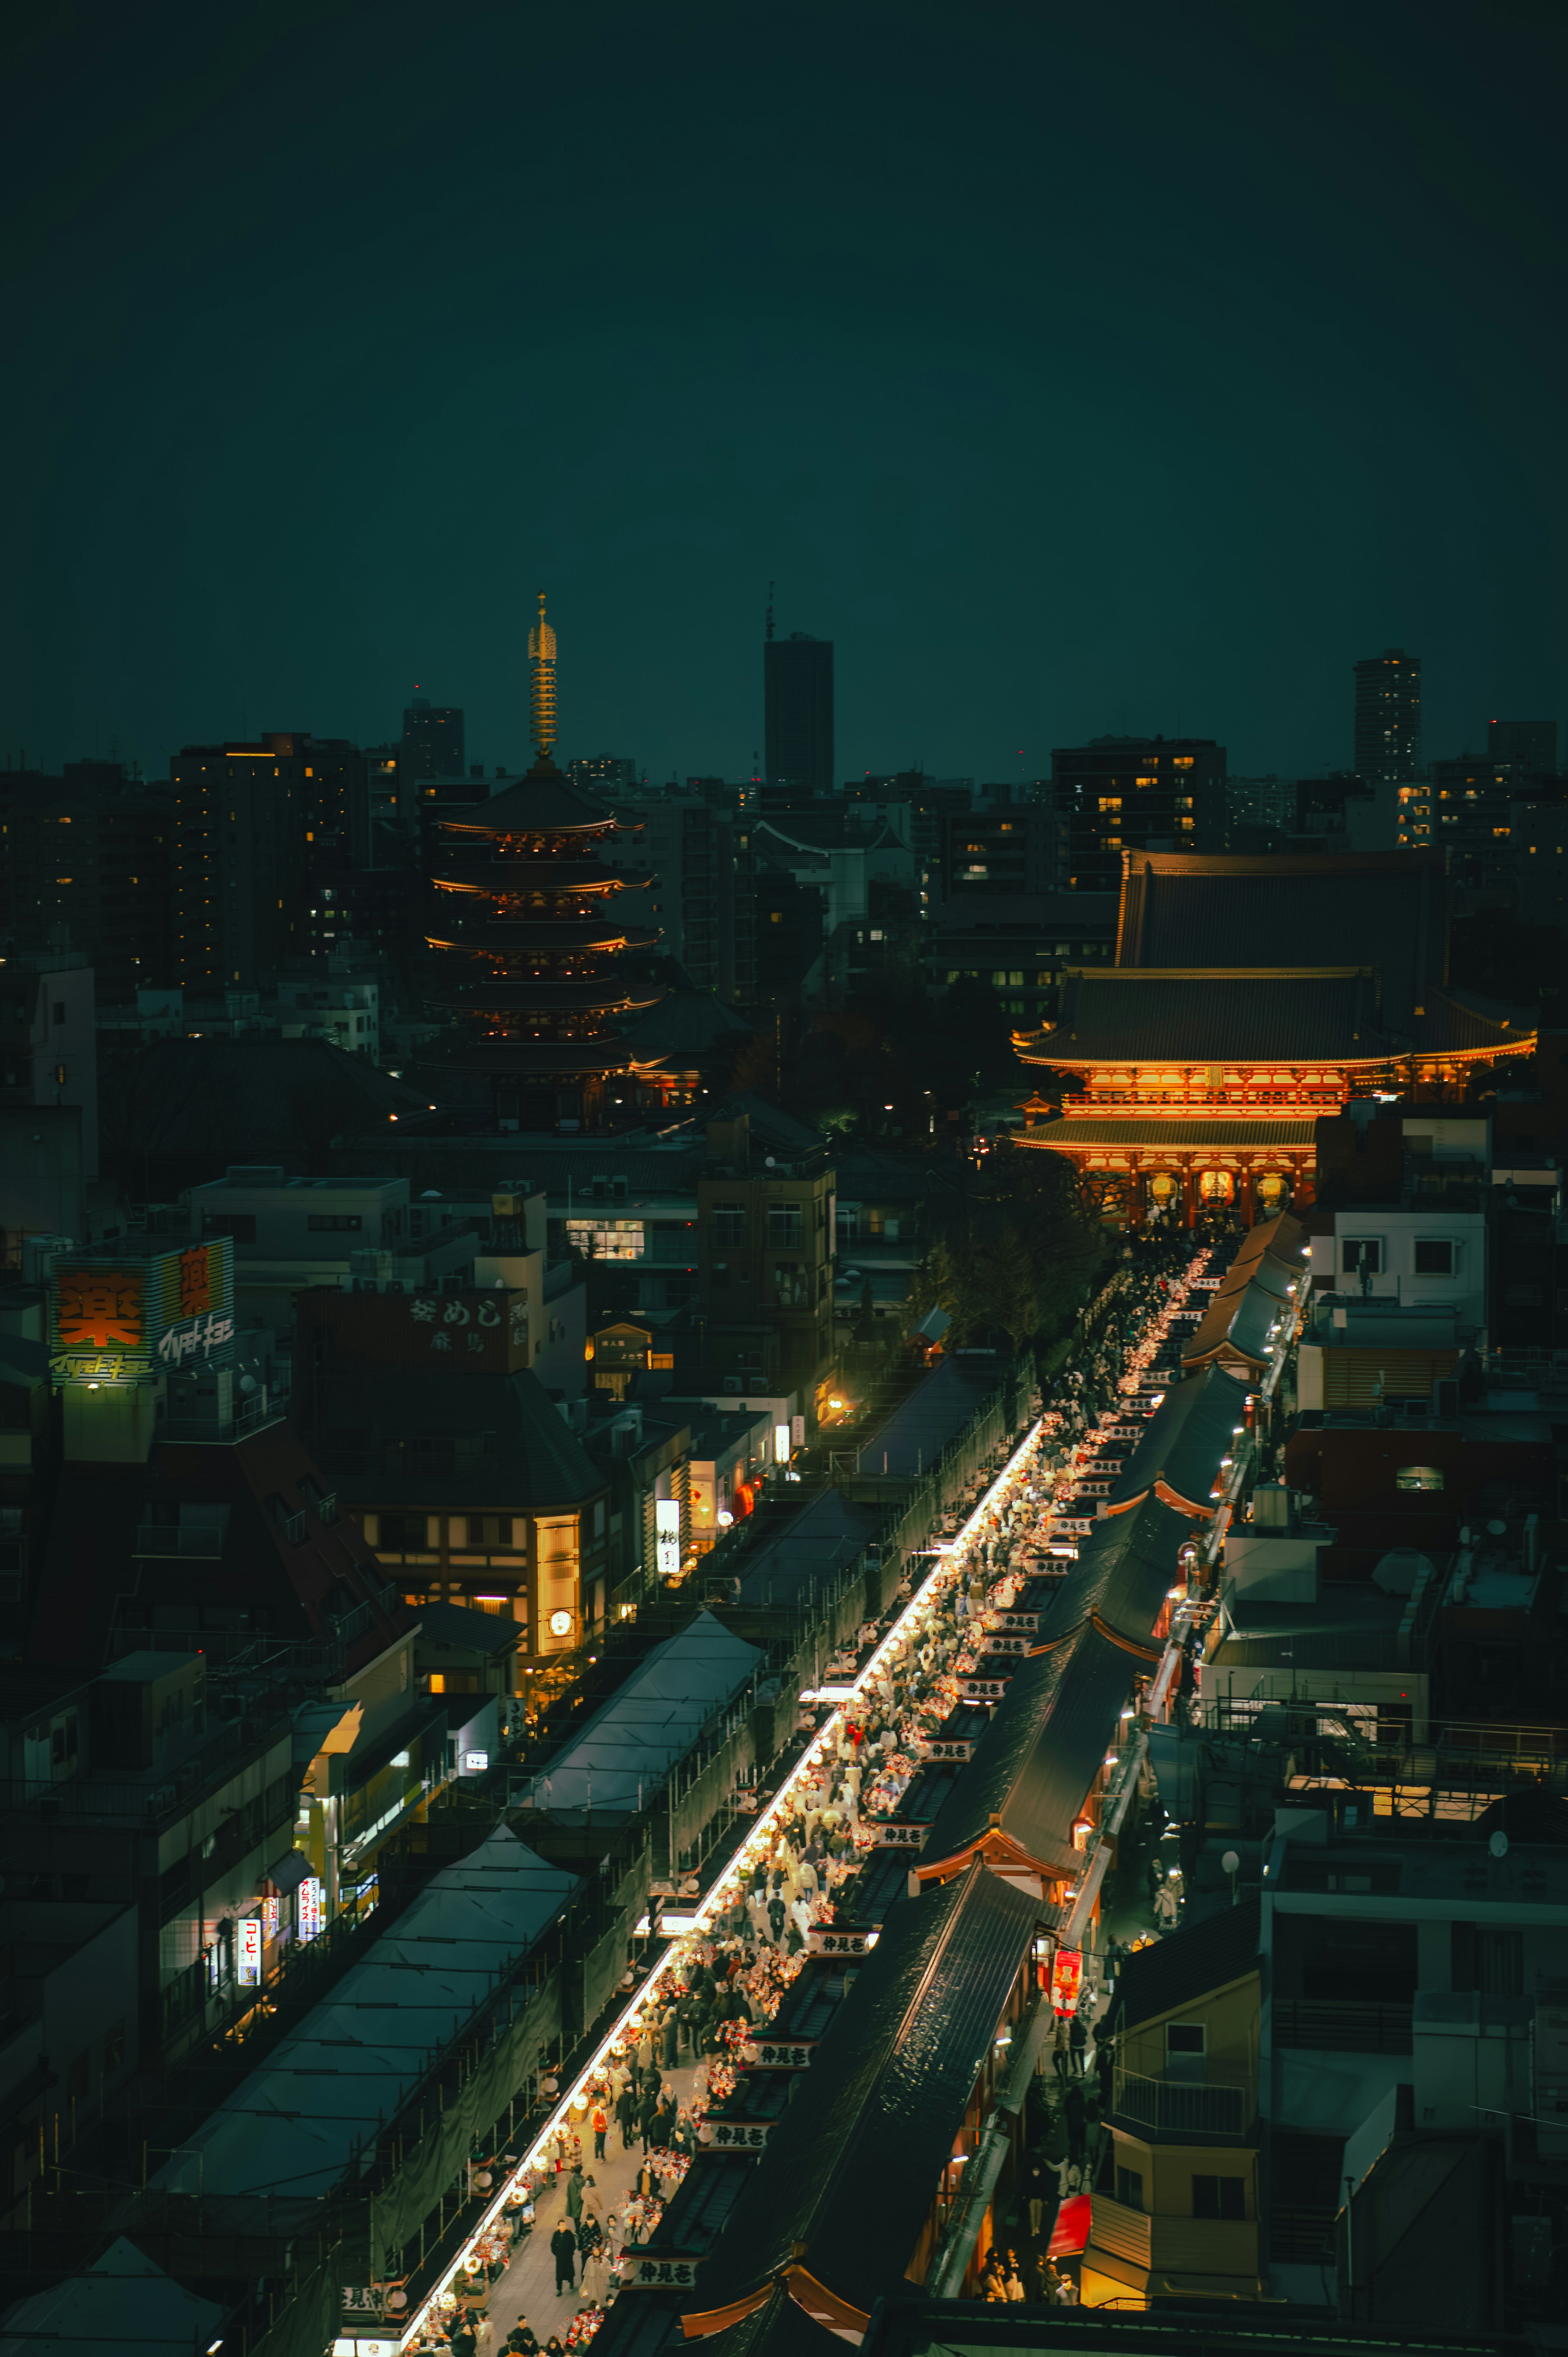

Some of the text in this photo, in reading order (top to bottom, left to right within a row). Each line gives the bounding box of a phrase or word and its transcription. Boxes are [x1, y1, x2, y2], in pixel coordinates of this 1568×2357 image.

[180, 1245, 210, 1317] 薬
[58, 1272, 143, 1347] 薬
[409, 1298, 502, 1327] 釜めし
[158, 1315, 235, 1367] マツモトキヨシ
[49, 1353, 154, 1379] マツモトキヨシ
[301, 1880, 310, 1920] オムライス
[246, 1922, 257, 1961] コーヒー
